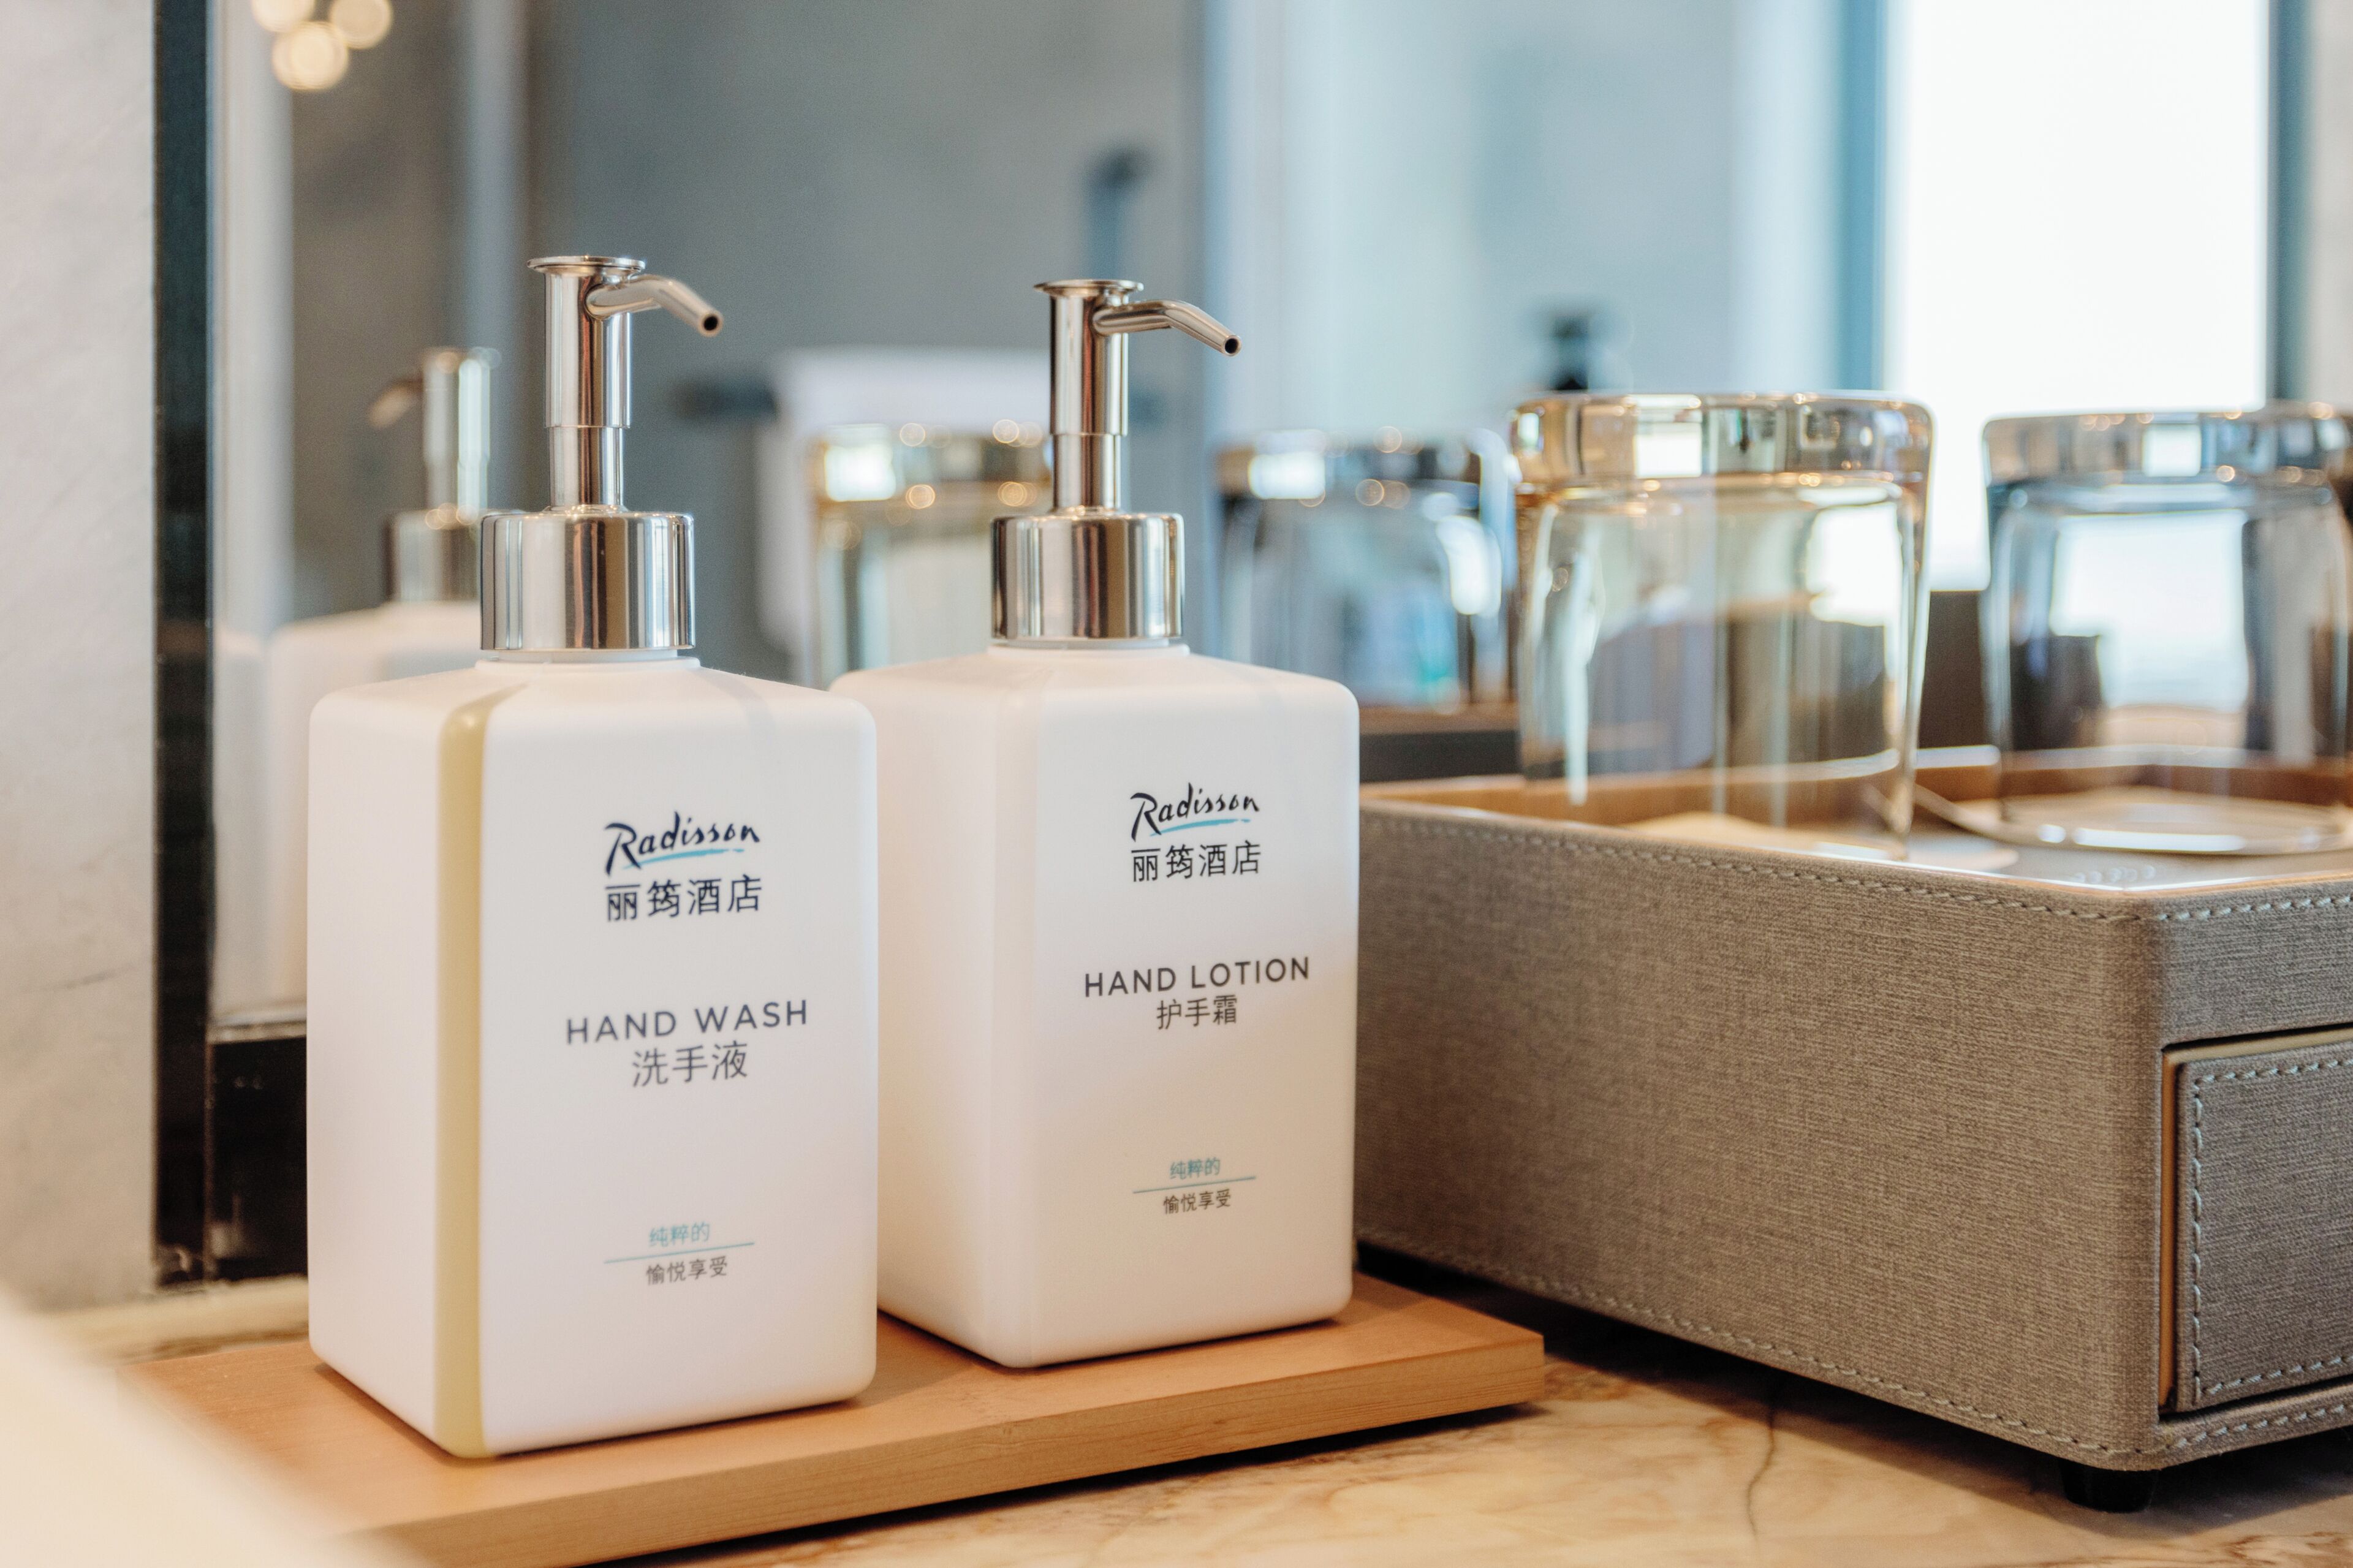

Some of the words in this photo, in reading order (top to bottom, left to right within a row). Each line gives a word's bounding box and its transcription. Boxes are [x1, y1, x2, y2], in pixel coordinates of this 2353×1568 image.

[1130, 782, 1260, 842] Radisson
[604, 810, 760, 877] Radisson
[1131, 840, 1261, 882] 丽筠酒店
[604, 874, 762, 922] 丽筠酒店
[1085, 968, 1176, 998] HAND
[1191, 956, 1309, 989] LOTION
[566, 1011, 676, 1044] HAND
[694, 999, 807, 1034] WASH
[1156, 994, 1238, 1029] 护手霜
[632, 1040, 748, 1087] 洗手液
[1169, 1157, 1221, 1180] 纯粹的
[1163, 1188, 1231, 1214] 愉悦享受
[648, 1221, 710, 1247] 纯粹的
[646, 1256, 727, 1285] 愉悦享受
